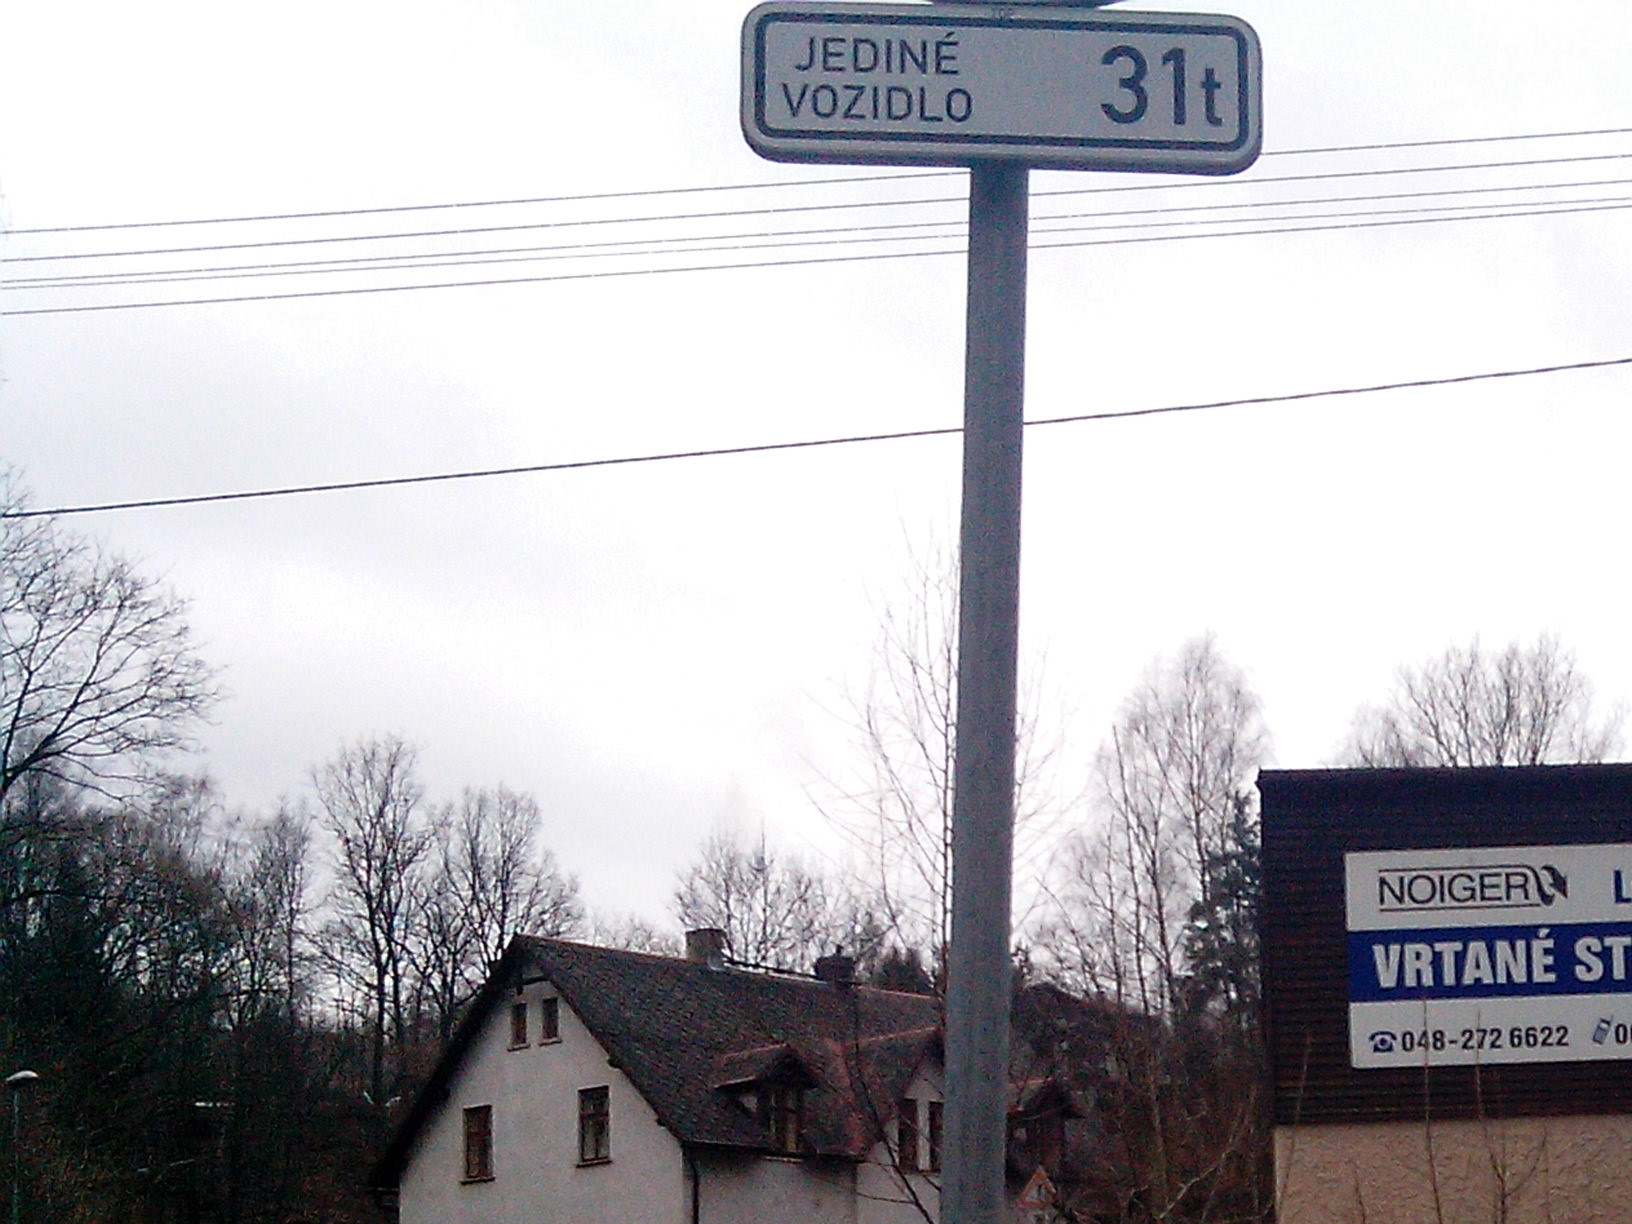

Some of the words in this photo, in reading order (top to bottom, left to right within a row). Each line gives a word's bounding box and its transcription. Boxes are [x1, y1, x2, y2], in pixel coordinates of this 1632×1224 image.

[794, 32, 961, 76] JEDINÉ
[782, 83, 973, 123] VOZIDLO
[1378, 872, 1531, 906] NOIGER
[1372, 928, 1556, 989] VRTANÉ
[1401, 1027, 1503, 1052] 048-272
[1509, 1026, 1570, 1048] 6622
